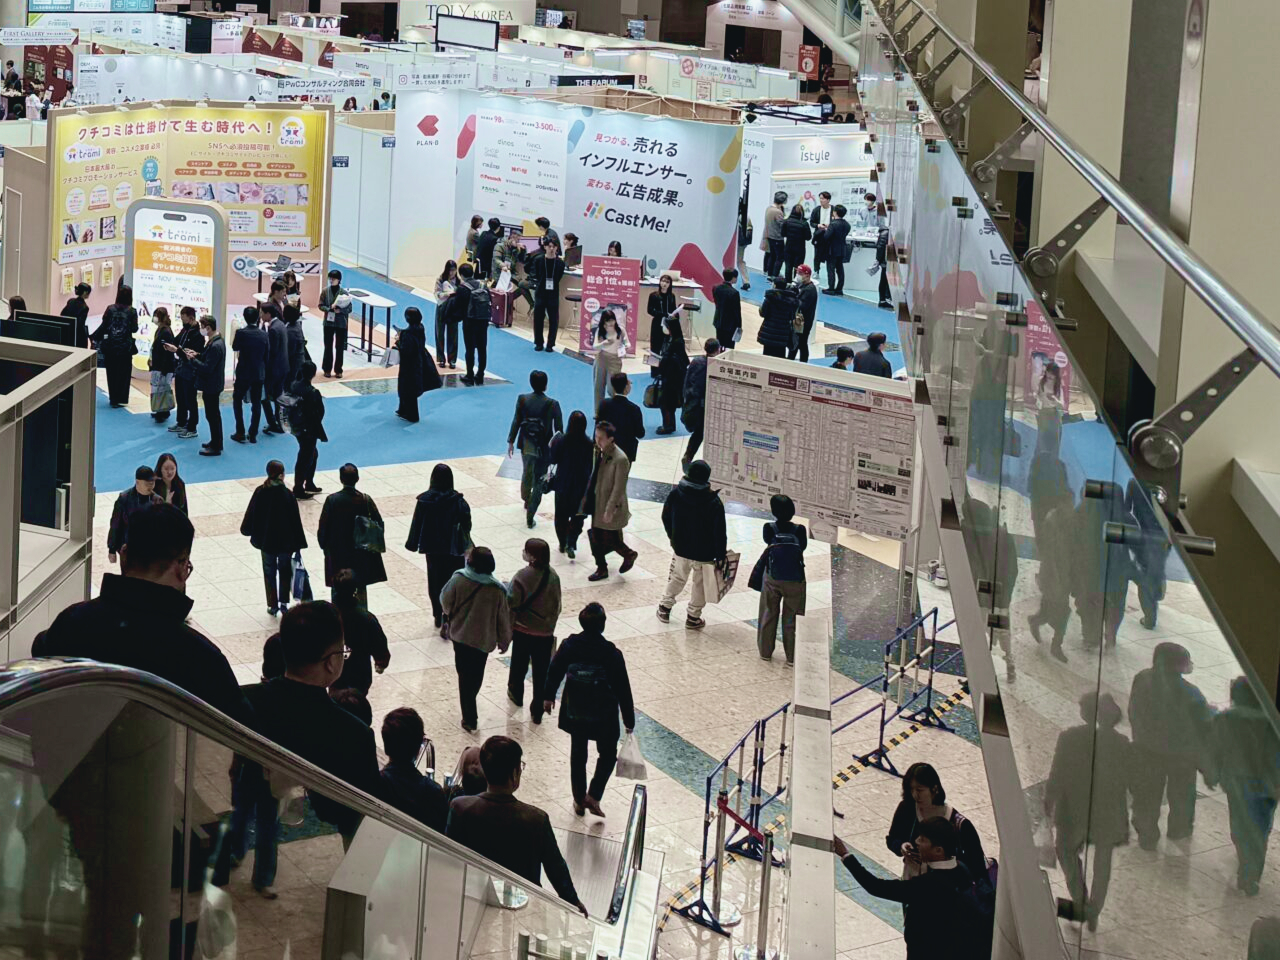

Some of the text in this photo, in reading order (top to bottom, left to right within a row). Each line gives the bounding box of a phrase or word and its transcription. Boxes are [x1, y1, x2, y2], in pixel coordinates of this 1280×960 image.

[426, 4, 513, 21] TOLY KOREA
[594, 133, 678, 157] 見つかる、 売れる
[800, 144, 830, 164] istyle
[63, 170, 138, 184] クチコミプロモーションサービス
[579, 153, 692, 185] インフルエンサー。
[586, 178, 683, 208] 変わる、 広告成果。
[604, 208, 671, 233] Cast Me!
[719, 366, 757, 380] 会場案内図
